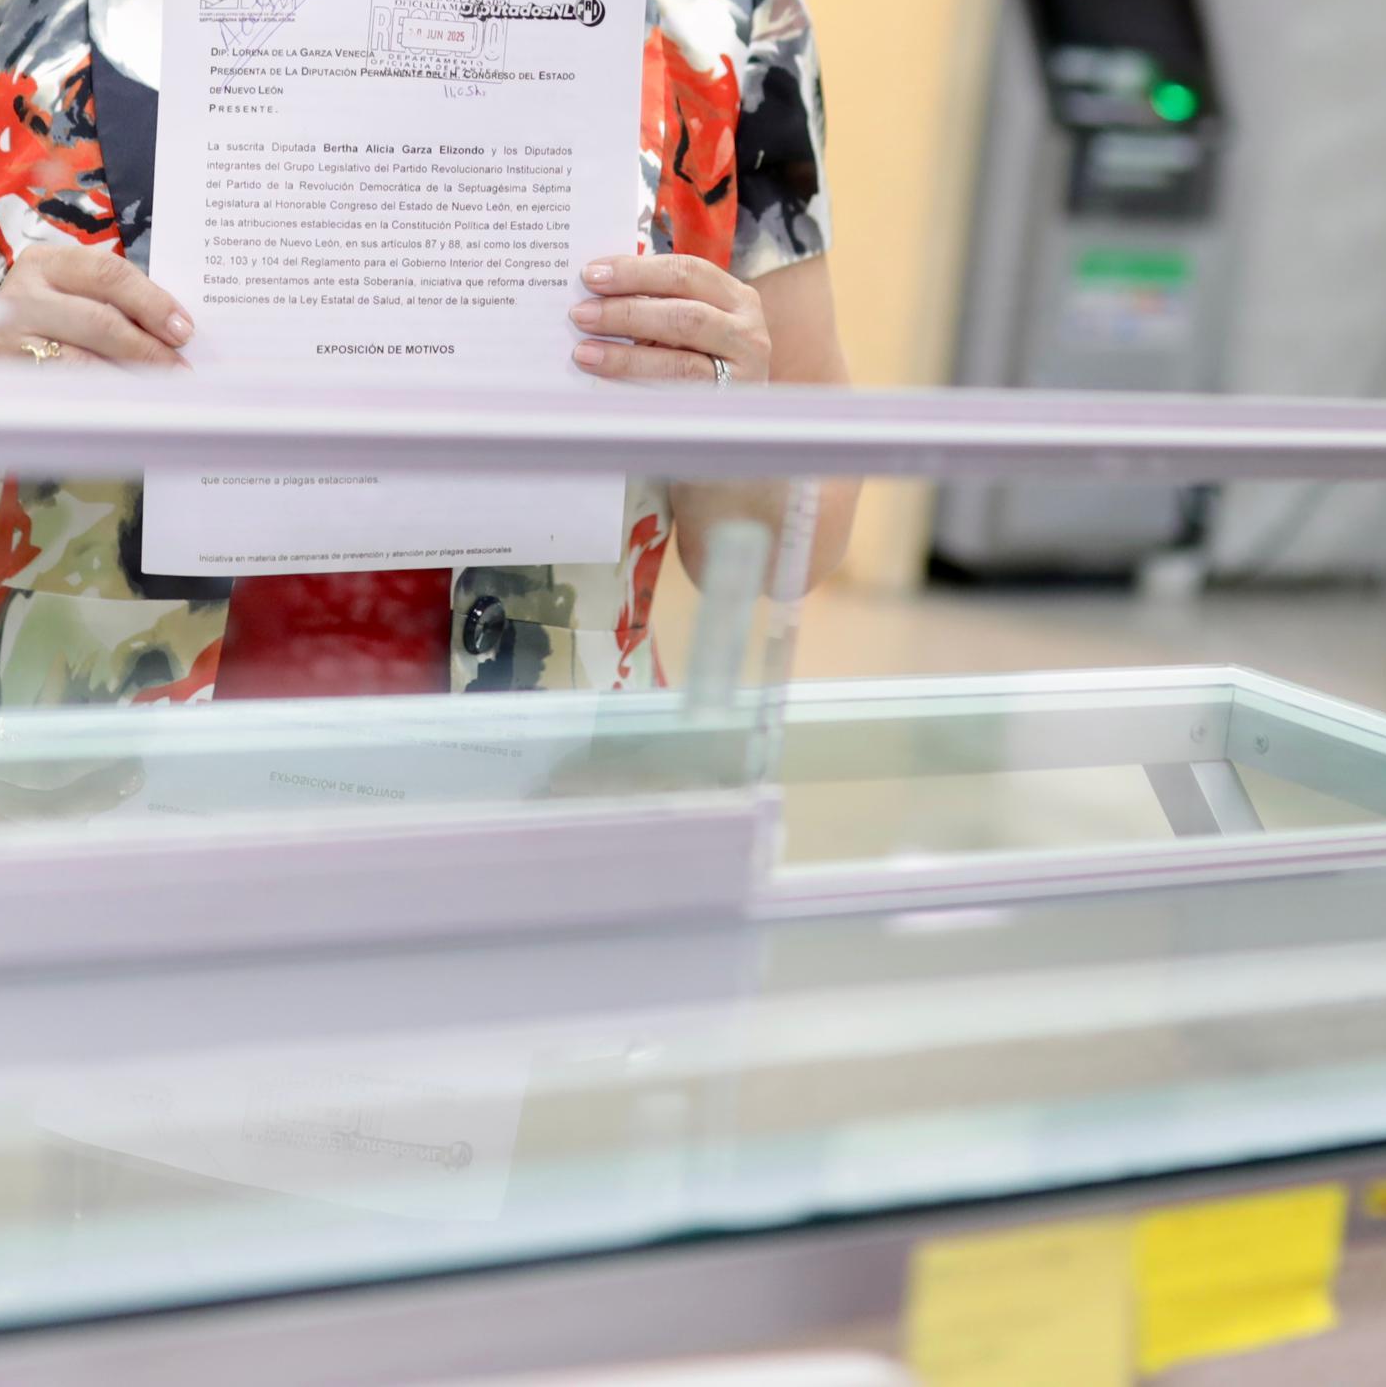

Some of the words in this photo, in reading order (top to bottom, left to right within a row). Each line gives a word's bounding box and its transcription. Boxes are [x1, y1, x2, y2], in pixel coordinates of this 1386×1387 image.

[427, 29, 443, 39] JUN
[447, 31, 465, 42] 2025
[389, 54, 483, 66] DEPARTAMENTO
[207, 141, 220, 152] La
[226, 142, 264, 152] suscrita
[271, 142, 316, 155] Diputada
[323, 143, 358, 153] Bertha
[365, 143, 395, 154] Alicia
[401, 144, 432, 154] Garza
[439, 144, 485, 155] Elizondo
[491, 146, 497, 157] y
[503, 145, 518, 155] los
[524, 145, 573, 158] Diputados
[206, 160, 261, 173] integrantes
[265, 161, 280, 171] del
[283, 161, 315, 174] Grupo
[318, 162, 371, 174] Legislativo
[374, 162, 389, 172] del
[393, 162, 428, 173] Partido
[431, 163, 503, 174] Revolucionario
[506, 164, 563, 174] Institucional
[566, 166, 572, 177] y
[206, 179, 221, 190] del
[226, 180, 262, 190] Partido
[267, 180, 279, 190] de
[285, 180, 294, 190] la
[299, 180, 354, 191] Revolución
[359, 181, 421, 191] Democrática
[426, 182, 438, 192] de
[444, 182, 453, 192] la
[457, 182, 527, 195] Septuagésima
[532, 183, 571, 195] Séptima
[205, 198, 260, 211] Legislatura
[263, 199, 272, 209] al
[275, 199, 326, 209] Honorable
[329, 199, 378, 212] Congreso
[380, 200, 395, 210] del
[398, 200, 433, 210] Estado
[436, 200, 448, 210] de
[451, 200, 483, 211] Nuevo
[516, 202, 528, 211] en
[531, 201, 571, 214] ejercicio
[205, 217, 217, 227] de
[220, 217, 235, 227] las
[238, 217, 297, 228] atribuciones
[300, 218, 362, 229] establecidas
[364, 220, 377, 229] en
[380, 219, 389, 229] la
[391, 219, 451, 229] Constitución
[454, 219, 490, 230] Política
[492, 220, 507, 230] del
[510, 220, 544, 230] Estado
[546, 220, 570, 230] Libre
[204, 238, 210, 248] y
[213, 236, 262, 247] Soberano
[264, 237, 277, 247] de
[279, 237, 312, 247] Nuevo
[345, 239, 358, 247] en
[361, 239, 378, 248] sus
[381, 238, 422, 248] artículos
[425, 238, 437, 248] 87
[439, 240, 445, 250] y
[466, 238, 481, 249] así
[483, 240, 510, 249] como
[513, 239, 527, 249] los
[529, 239, 569, 249] diversos
[230, 256, 248, 266] 103
[251, 257, 258, 268] y
[261, 256, 279, 266] 104
[283, 256, 298, 266] del
[301, 256, 361, 269] Reglamento
[364, 258, 386, 269] para
[389, 257, 398, 267] el
[401, 257, 446, 267] Gobierno
[449, 257, 483, 267] Interior
[486, 257, 501, 267] del
[504, 257, 551, 270] Congreso
[554, 258, 569, 268] del
[245, 275, 310, 287] presentamos
[313, 275, 335, 285] ante
[338, 275, 360, 285] esta
[420, 276, 462, 286] iniciativa
[465, 278, 484, 288] que
[487, 276, 525, 286] reforma
[528, 276, 568, 286] diversas
[203, 294, 270, 306] disposiciones
[273, 294, 285, 304] de
[288, 294, 297, 304] la
[300, 294, 318, 306] Ley
[321, 294, 355, 304] Estatal
[357, 294, 370, 304] de
[406, 295, 415, 305] al
[418, 295, 442, 305] tenor
[445, 295, 457, 305] de
[460, 295, 469, 305] la
[316, 342, 384, 354] EXPOSICIÓN
[387, 344, 402, 354] DE
[405, 344, 455, 354] MOTIVOS
[201, 477, 219, 485] que
[283, 476, 314, 486] plagas
